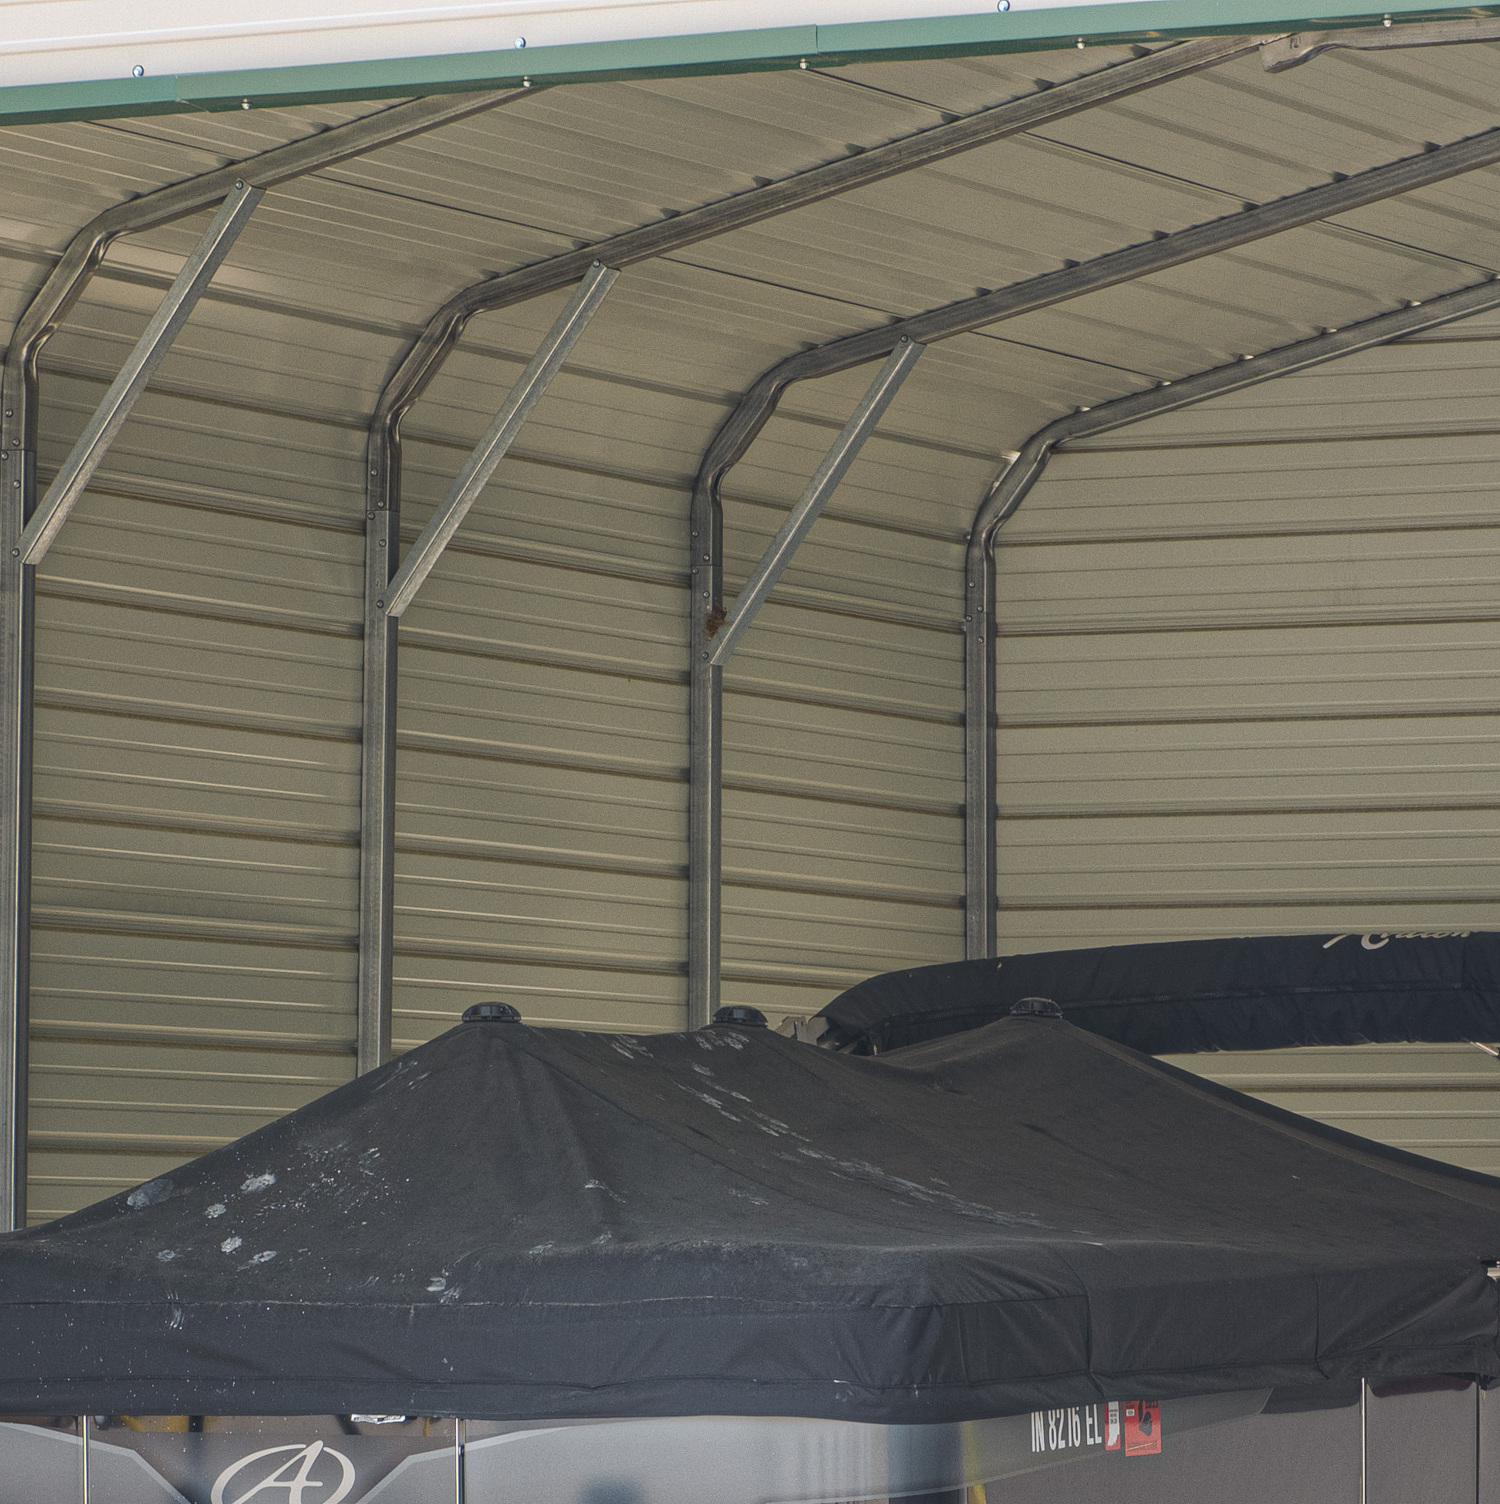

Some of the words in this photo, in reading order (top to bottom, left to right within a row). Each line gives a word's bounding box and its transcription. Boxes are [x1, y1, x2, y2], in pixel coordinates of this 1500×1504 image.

[1031, 1411, 1046, 1452] IN
[1048, 1407, 1082, 1451] 8216
[1085, 1403, 1103, 1445] EL
